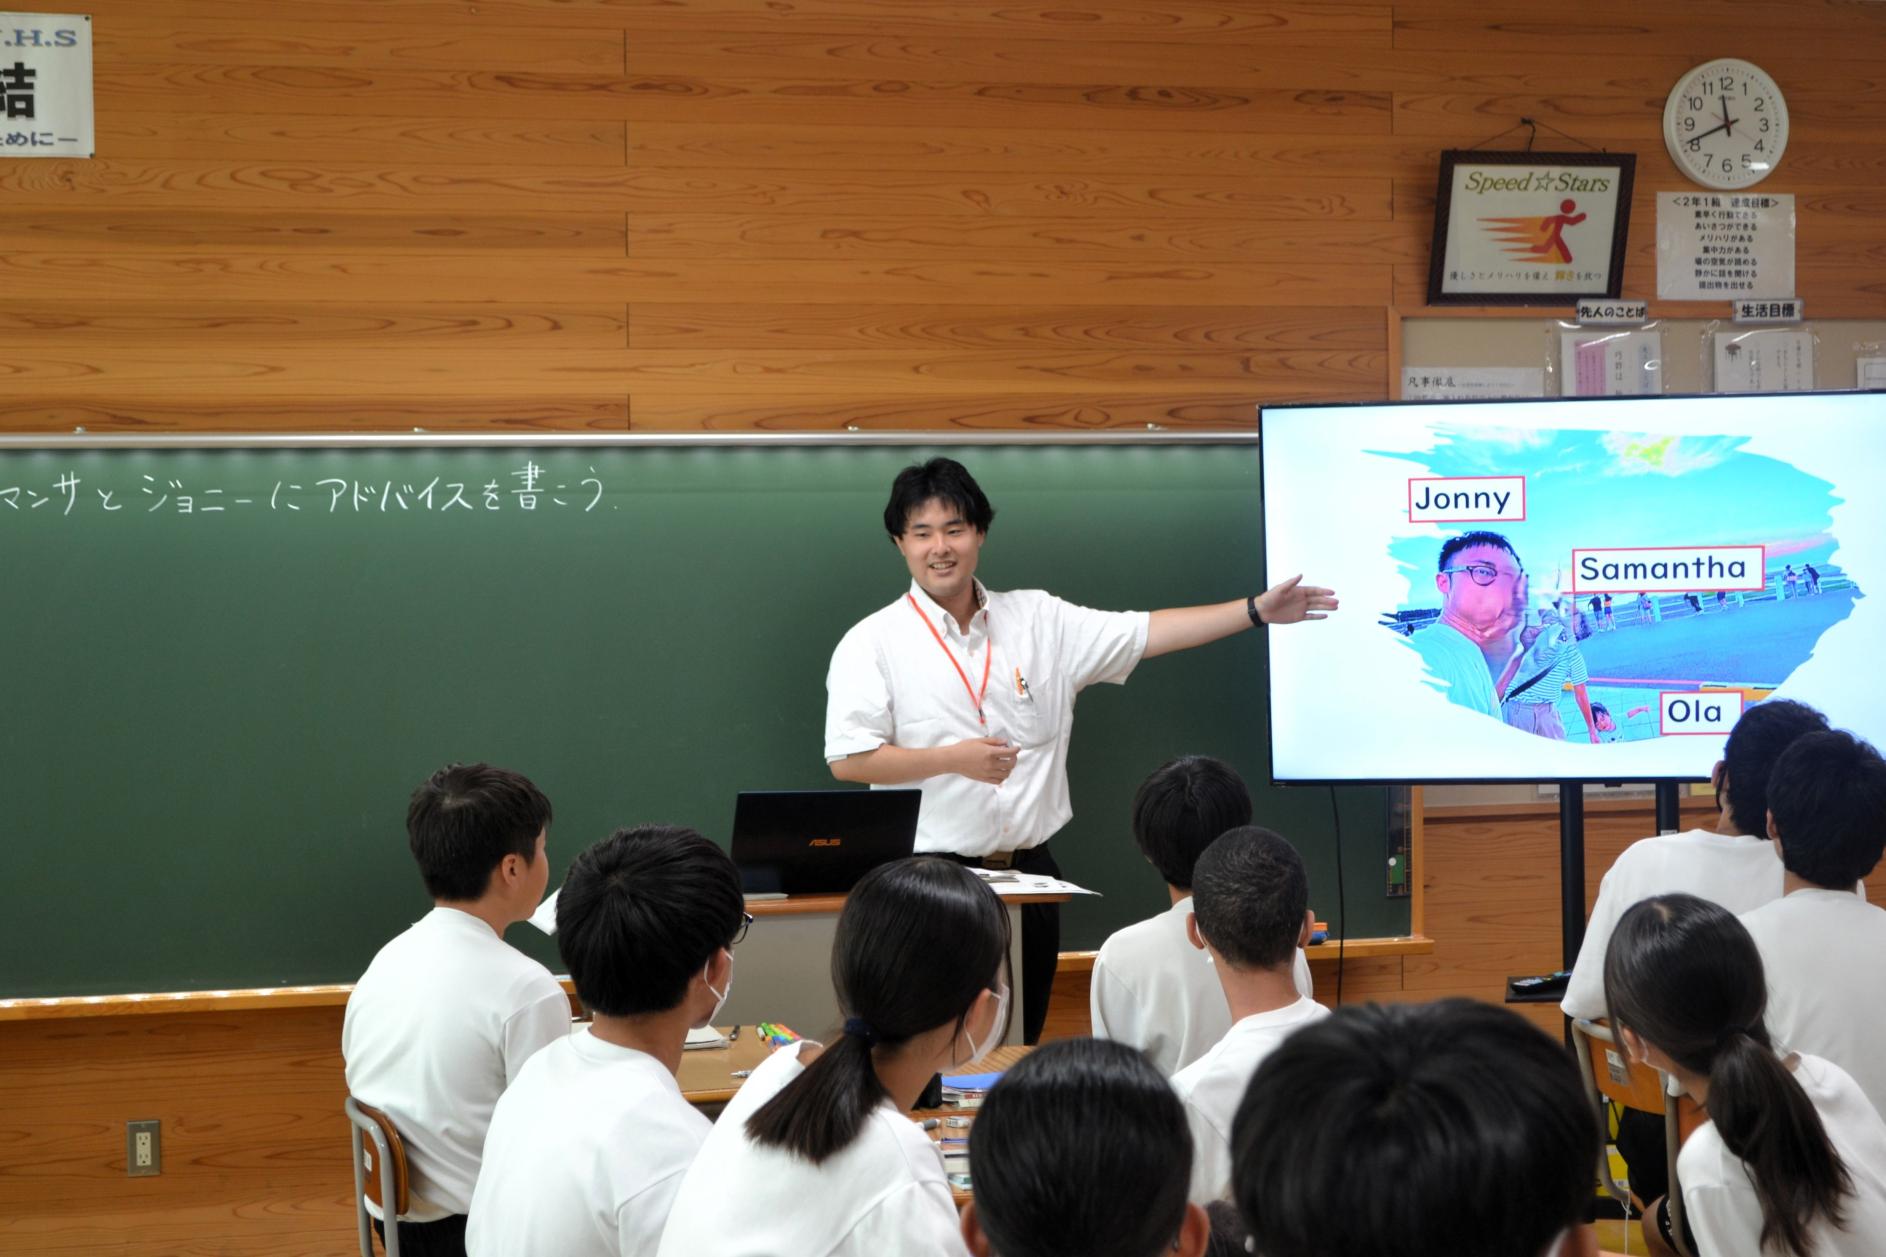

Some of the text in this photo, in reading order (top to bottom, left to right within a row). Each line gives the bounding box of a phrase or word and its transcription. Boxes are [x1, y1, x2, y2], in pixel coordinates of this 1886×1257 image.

[0, 29, 77, 47] .H.S
[1702, 82, 1714, 96] 11
[1720, 76, 1734, 91] 12
[1741, 82, 1748, 96] 1
[1688, 96, 1703, 111] 10
[1754, 97, 1764, 112] 2
[1684, 117, 1695, 131] 9
[1759, 117, 1769, 132] 3
[1690, 137, 1701, 152] 8
[1754, 138, 1765, 152] 4
[1703, 154, 1713, 168] 7
[1722, 158, 1733, 173] 6
[1741, 154, 1752, 168] 5
[1464, 171, 1611, 194] Speed Stars
[1580, 306, 1646, 319] 先人のことば
[1741, 303, 1796, 318] 生活目標
[1415, 487, 1511, 514] Jonny
[1580, 555, 1746, 581] Samantha
[1668, 699, 1722, 723] Ola
[808, 838, 841, 847] ASUS
